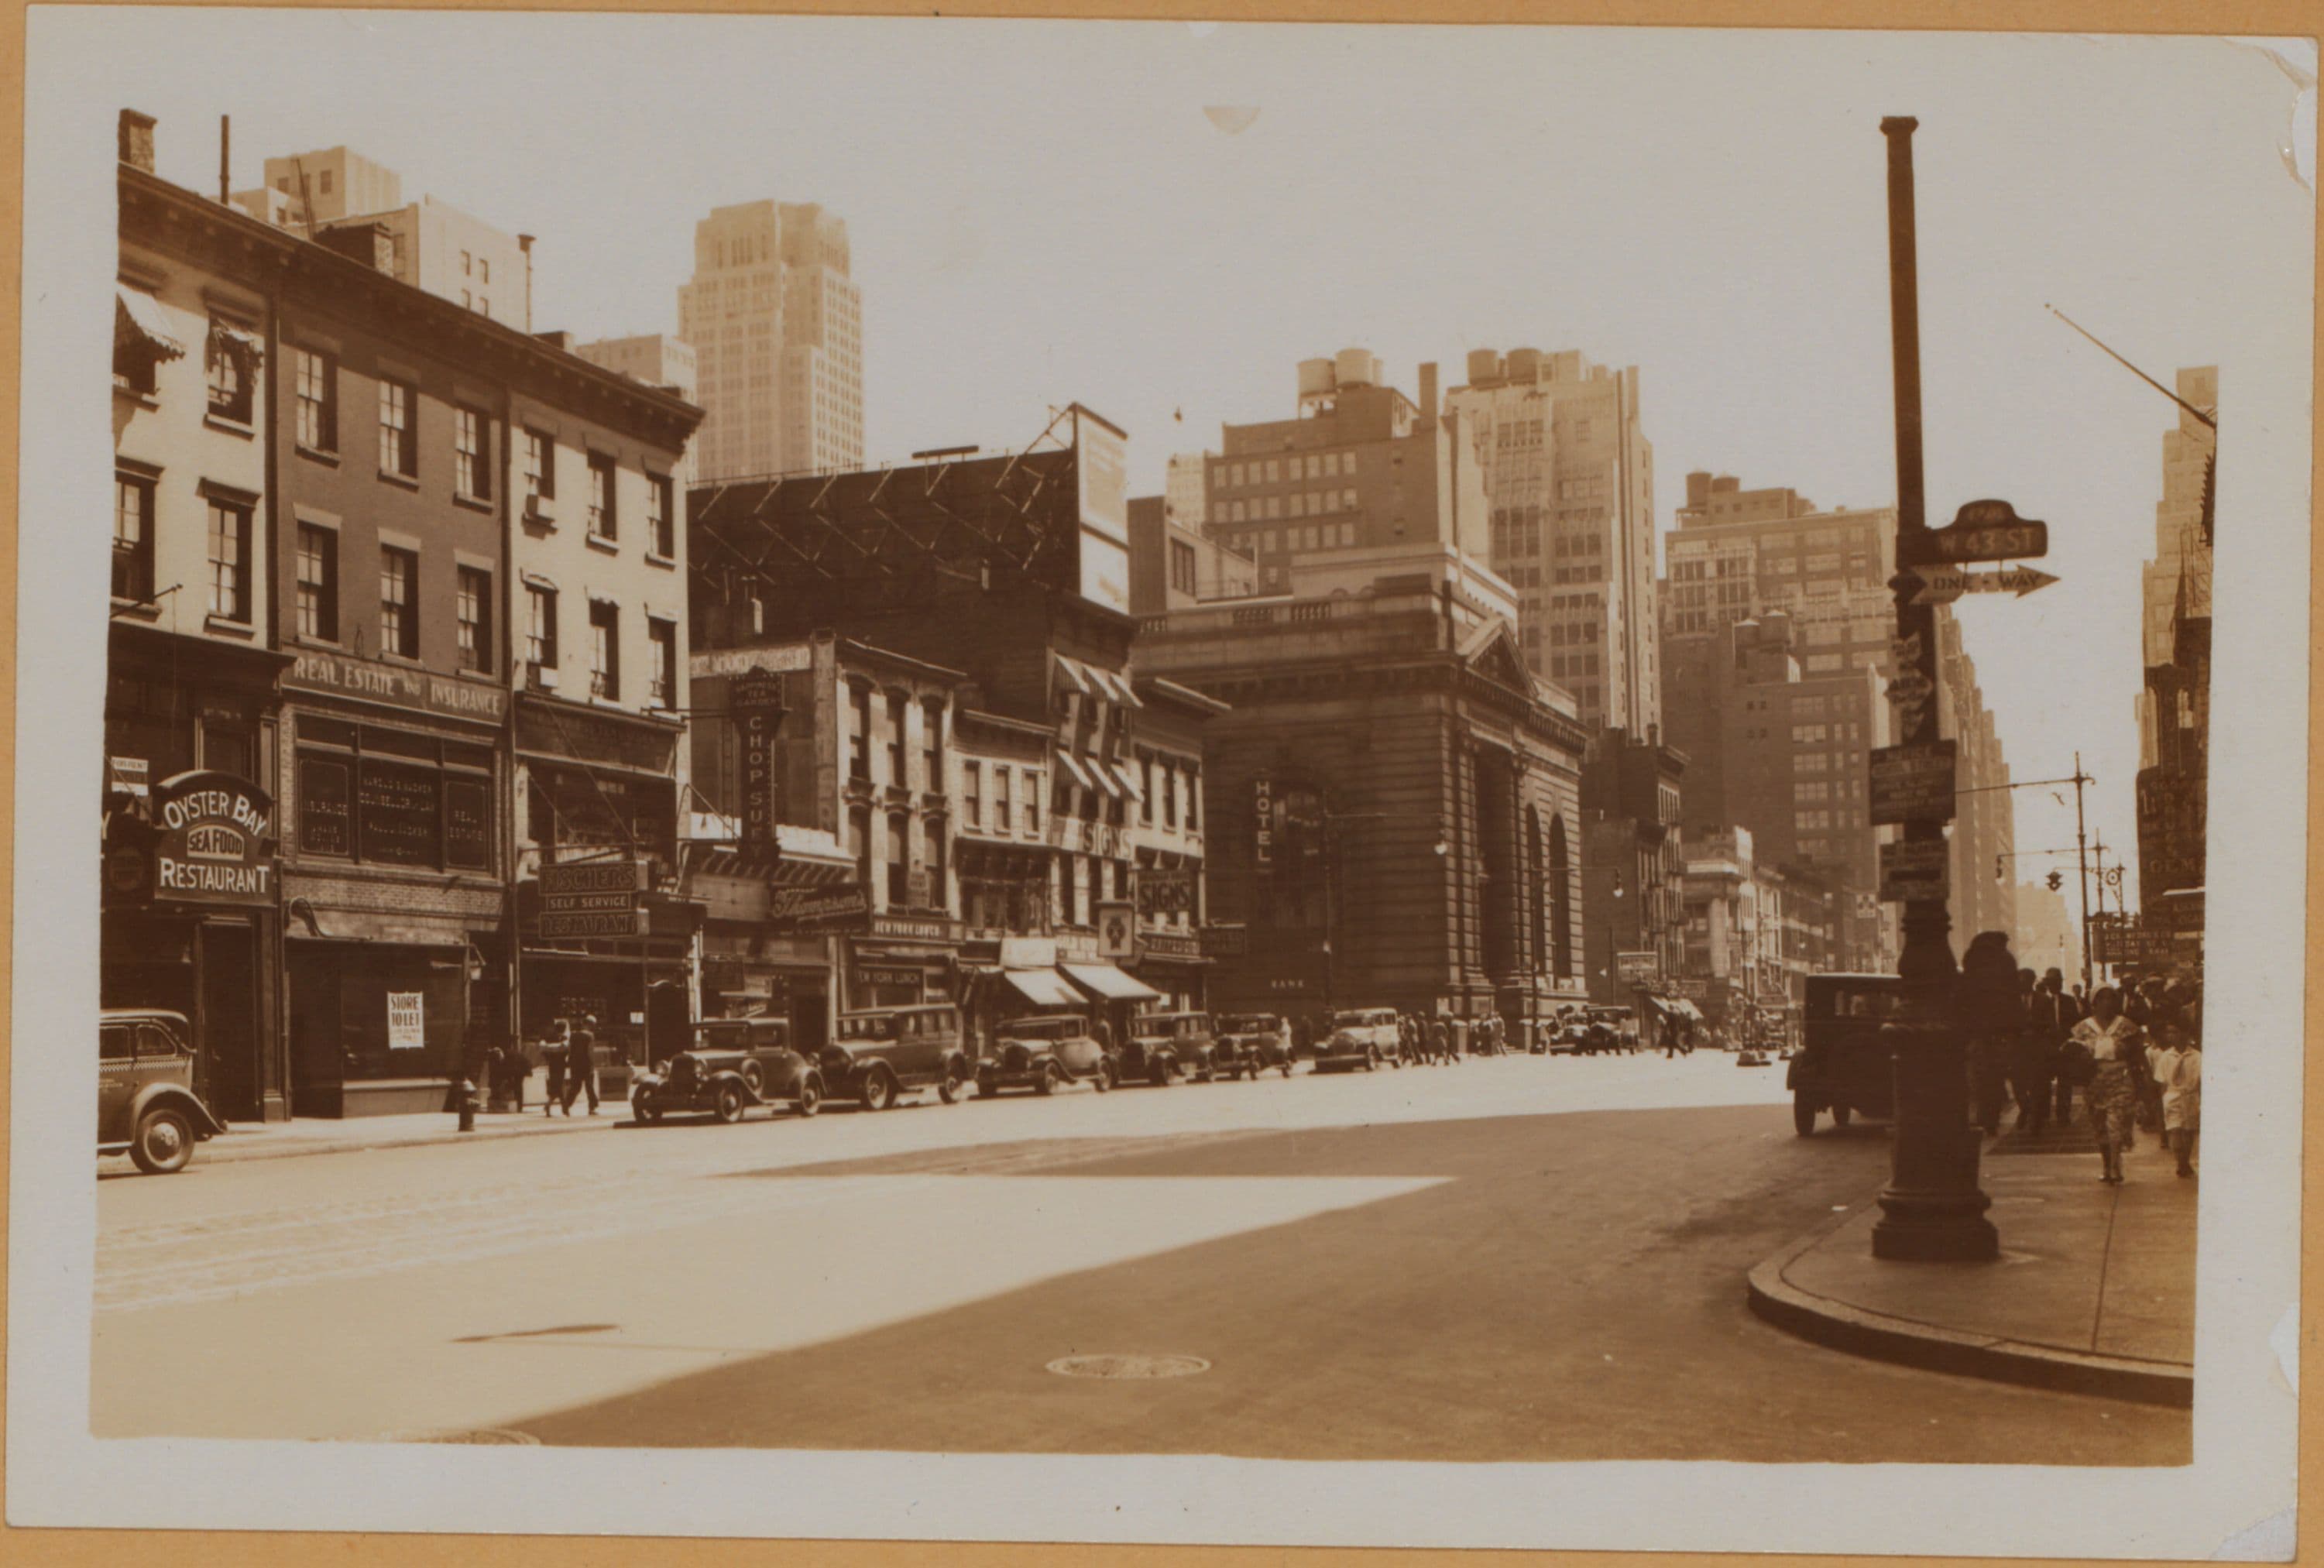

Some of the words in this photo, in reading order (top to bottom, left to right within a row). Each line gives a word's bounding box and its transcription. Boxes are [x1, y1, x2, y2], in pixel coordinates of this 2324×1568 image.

[1939, 534, 1956, 552] W
[1965, 531, 1996, 554] 43
[2006, 527, 2034, 552] ST
[1933, 575, 1973, 591] ONE
[1998, 573, 2041, 590] WAY
[294, 656, 340, 685] REAL
[344, 664, 395, 696] ESTATE
[430, 682, 500, 716] INSURANCE
[749, 715, 764, 784] CHOP
[164, 791, 230, 829] OYSTER
[232, 794, 267, 836] BAY
[1255, 781, 1272, 863] HOTEL
[188, 829, 211, 853] SEA
[212, 829, 242, 855] FOOD
[1083, 822, 1132, 861] SIGNS
[160, 856, 270, 894] RESTAURANT
[551, 897, 576, 909] SELF
[582, 896, 626, 908] SERVICE
[1139, 881, 1190, 910] SIGNS
[542, 914, 637, 935] RESTAURANT
[893, 921, 914, 935] YORK
[873, 971, 893, 985] YORK
[894, 972, 920, 985] LUNCH
[390, 995, 420, 1010] STORE
[391, 1012, 403, 1027] TO
[403, 1012, 420, 1028] LET
